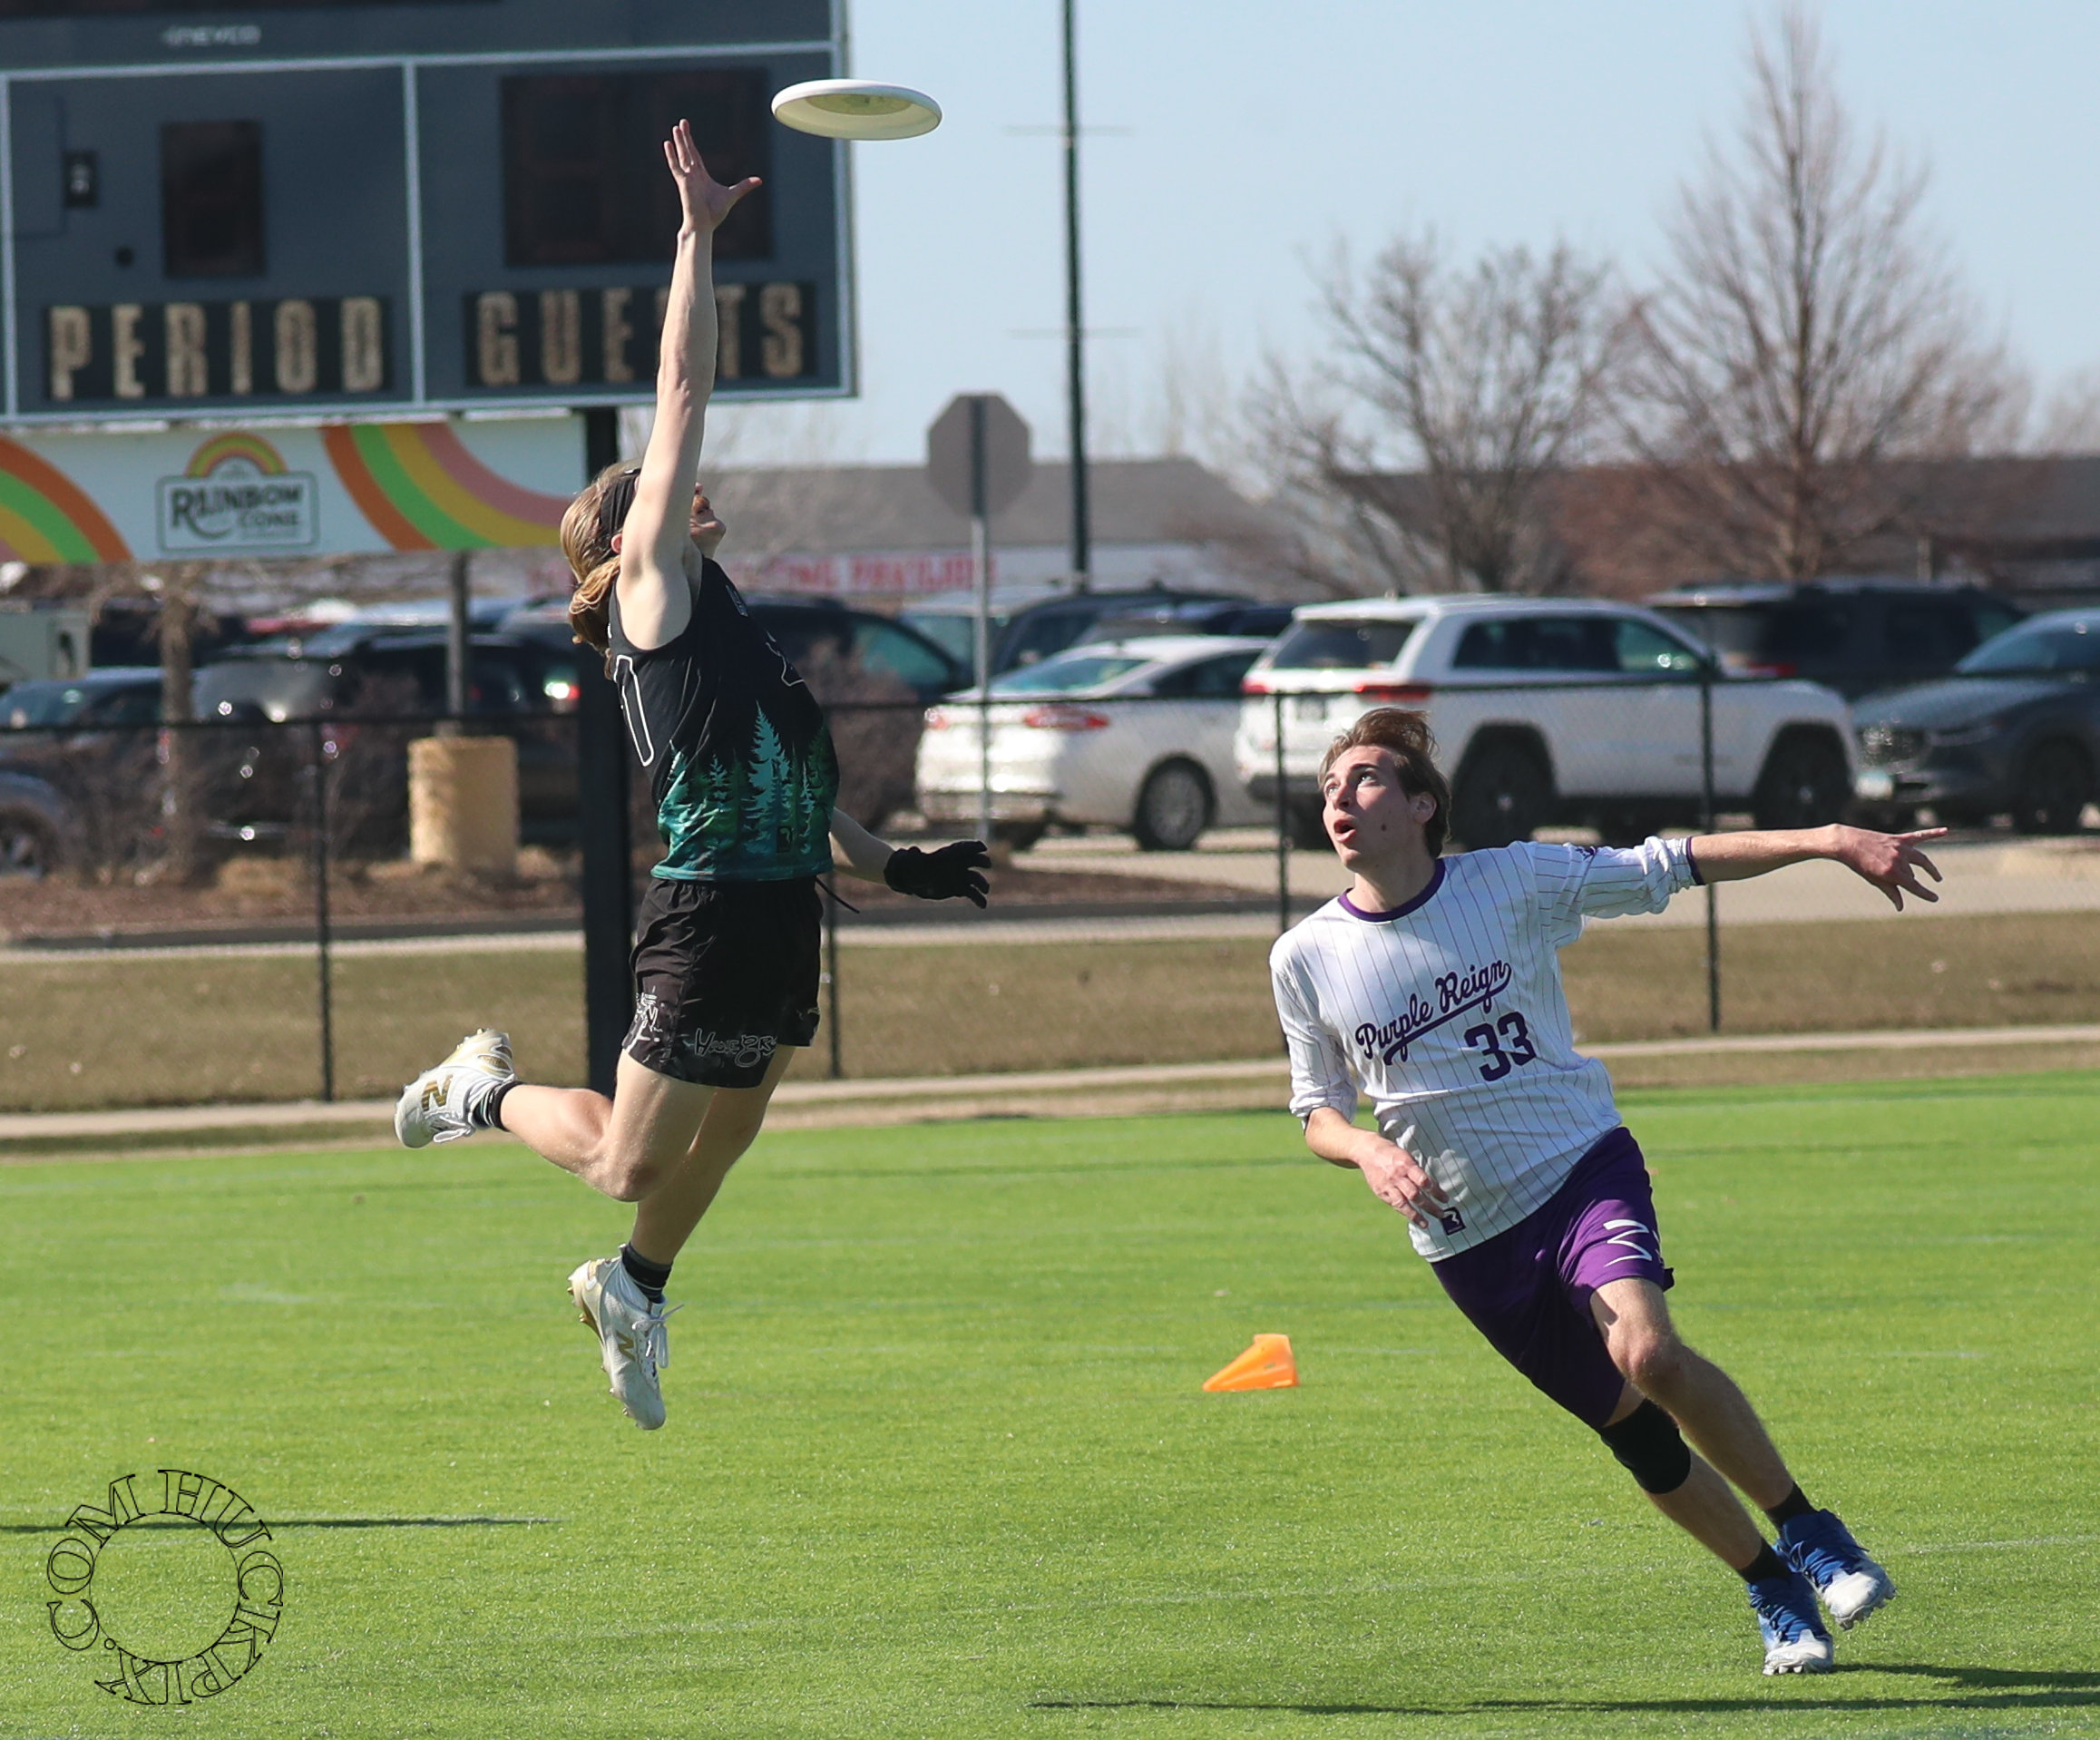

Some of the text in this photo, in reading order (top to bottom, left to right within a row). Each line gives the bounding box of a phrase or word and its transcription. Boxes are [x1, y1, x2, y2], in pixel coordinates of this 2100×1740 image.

[49, 296, 385, 402] PERIOD
[476, 282, 804, 387] GUETS
[1355, 959, 1512, 1063] Purple Reign
[1463, 1011, 1538, 1082] 33
